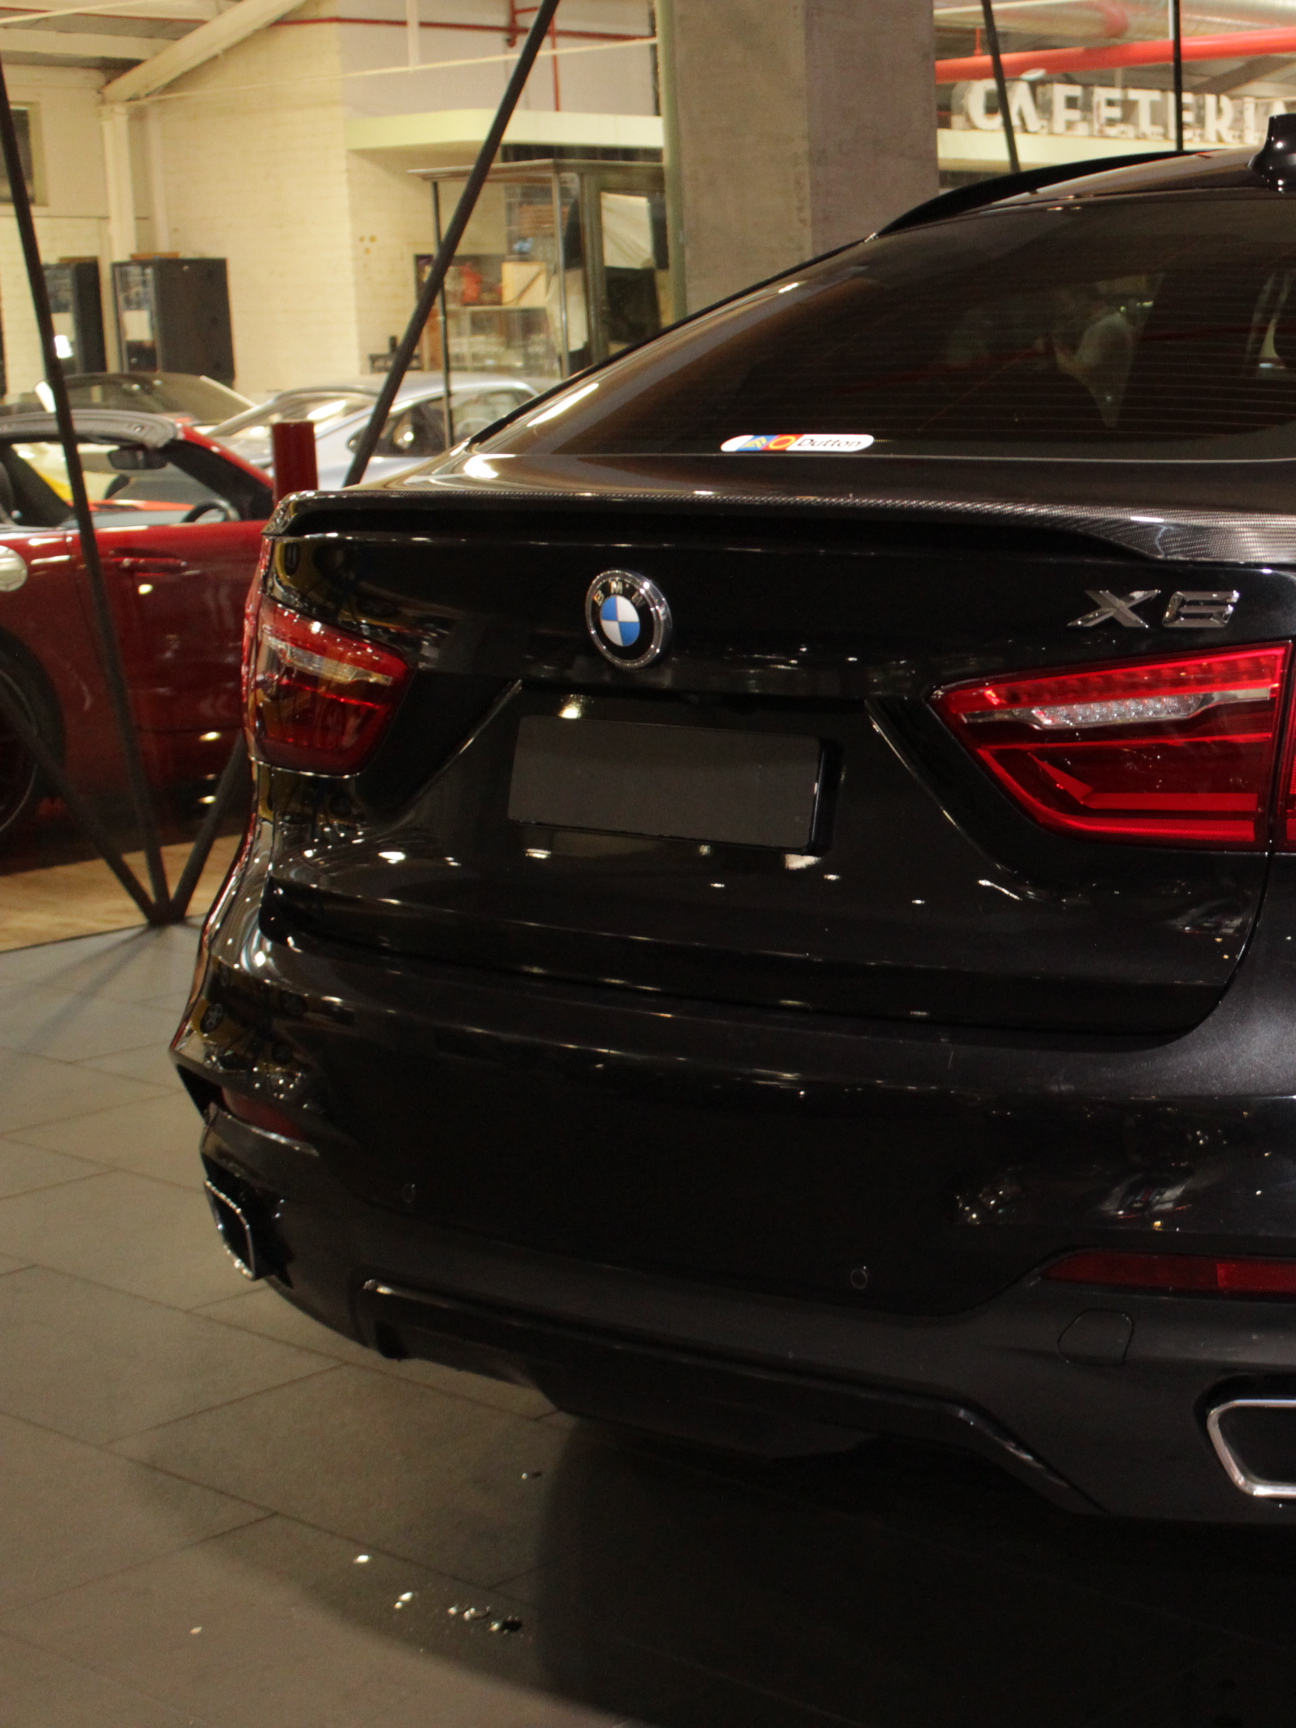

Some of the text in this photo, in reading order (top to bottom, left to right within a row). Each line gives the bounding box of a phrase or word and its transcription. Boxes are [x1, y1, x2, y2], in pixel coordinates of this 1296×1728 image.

[797, 438, 862, 448] Dutton
[593, 580, 646, 609] BMW
[1066, 589, 1240, 628] X6
